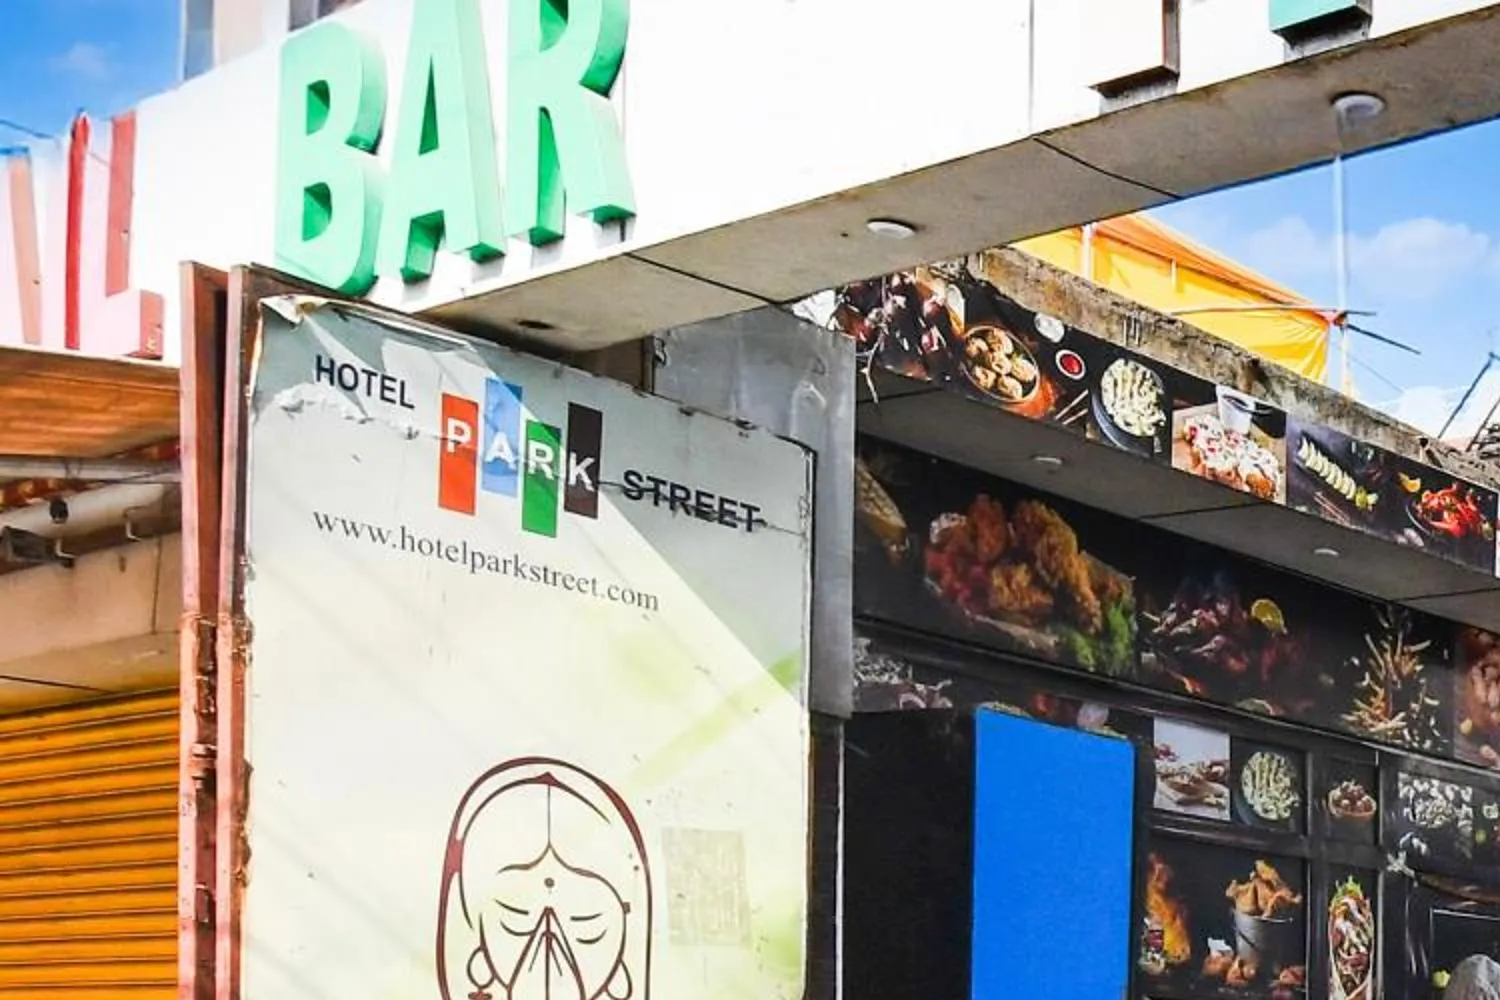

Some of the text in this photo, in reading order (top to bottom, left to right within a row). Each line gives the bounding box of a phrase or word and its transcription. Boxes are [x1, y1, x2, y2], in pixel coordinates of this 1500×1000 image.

[273, 0, 637, 297] BAR
[315, 354, 415, 410] HOTEL
[622, 468, 764, 534] STREET
[313, 508, 660, 613] www.hotelparkstreet.com
